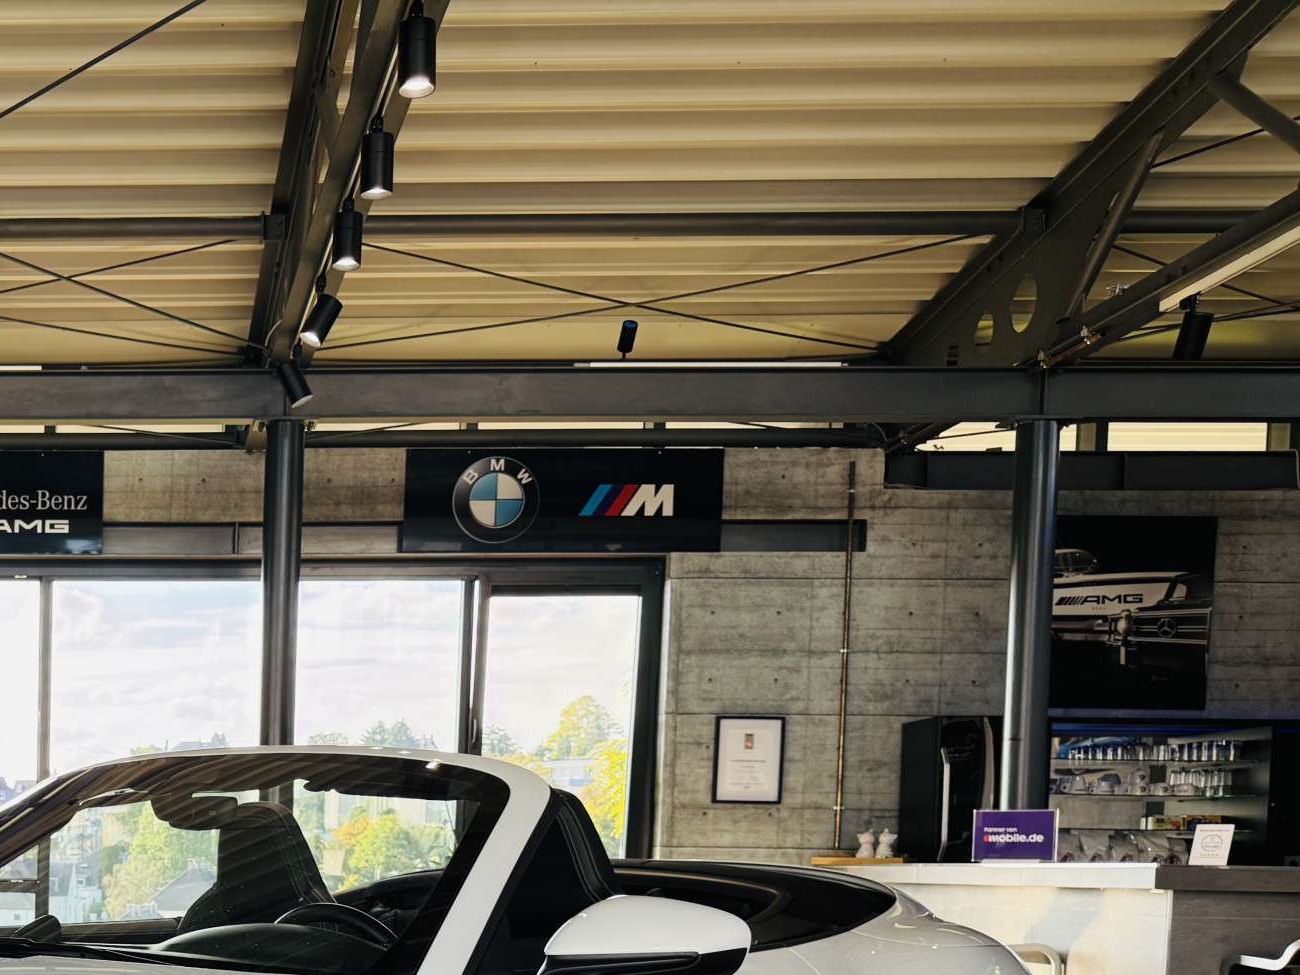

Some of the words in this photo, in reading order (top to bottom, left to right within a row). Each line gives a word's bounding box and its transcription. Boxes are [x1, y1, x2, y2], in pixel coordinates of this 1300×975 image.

[462, 458, 533, 485] BMW
[1080, 593, 1144, 606] AMG
[984, 833, 1045, 843] mobile.de
